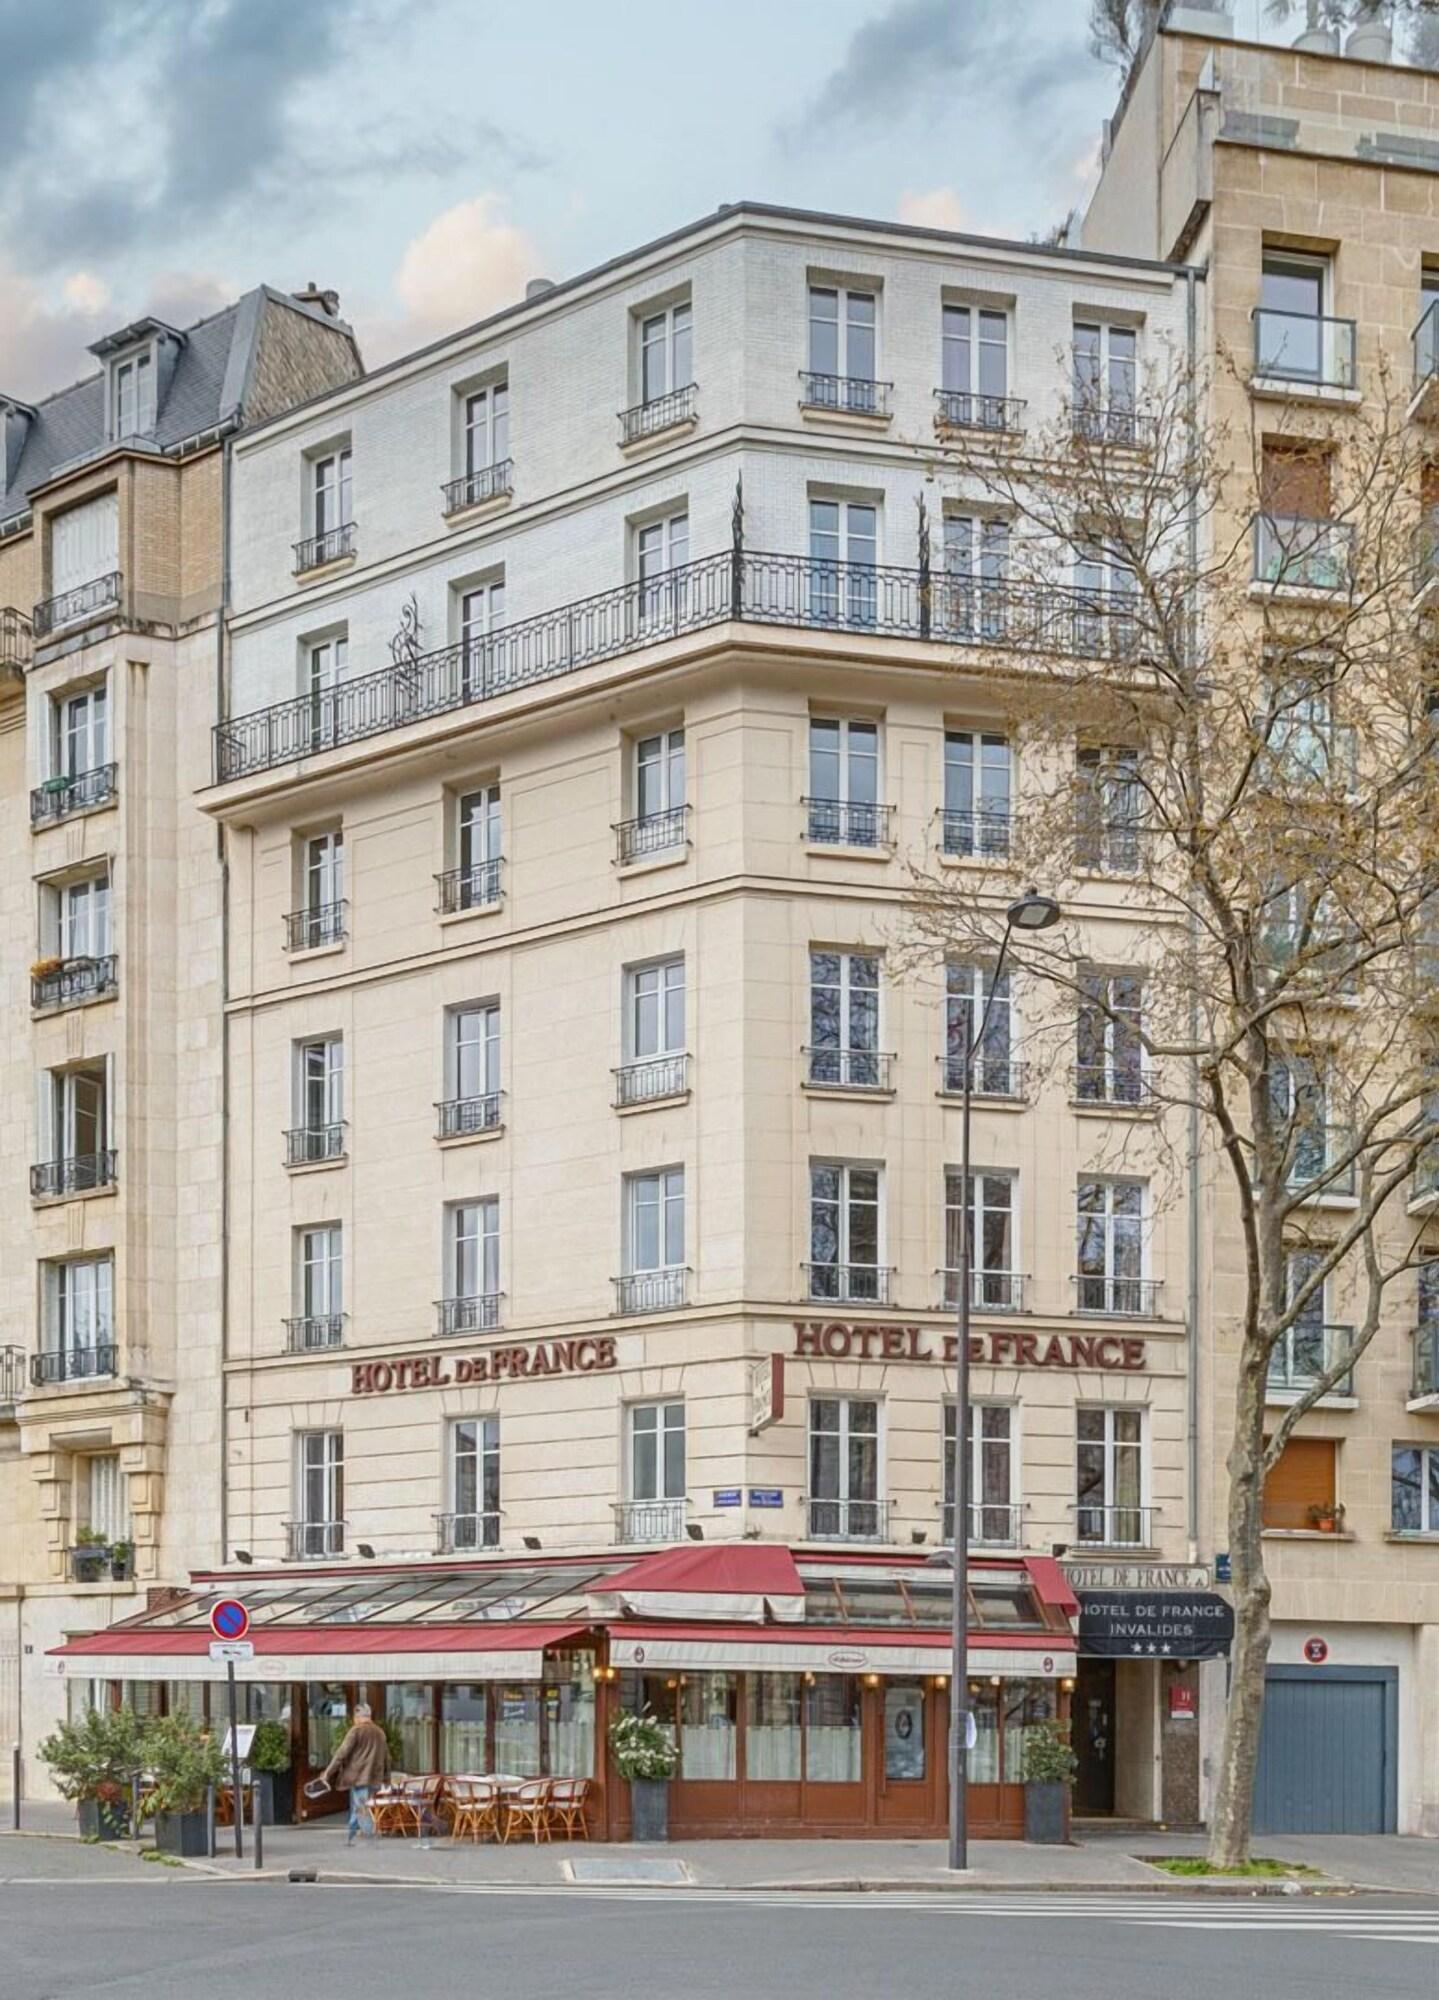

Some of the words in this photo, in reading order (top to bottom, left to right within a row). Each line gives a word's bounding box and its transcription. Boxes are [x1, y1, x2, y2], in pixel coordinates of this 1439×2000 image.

[793, 1322, 933, 1361] HOTEL
[988, 1332, 1146, 1371] FRANCE
[351, 1355, 450, 1394] HOTEL
[455, 1357, 487, 1382] DE
[489, 1336, 618, 1380] FRANCE
[1113, 1567, 1128, 1587] DE
[1137, 1567, 1191, 1587] FRANCE
[1135, 1605, 1157, 1617] DE
[1162, 1605, 1225, 1618] FRANCE
[1110, 1623, 1193, 1637] INVALIDES
